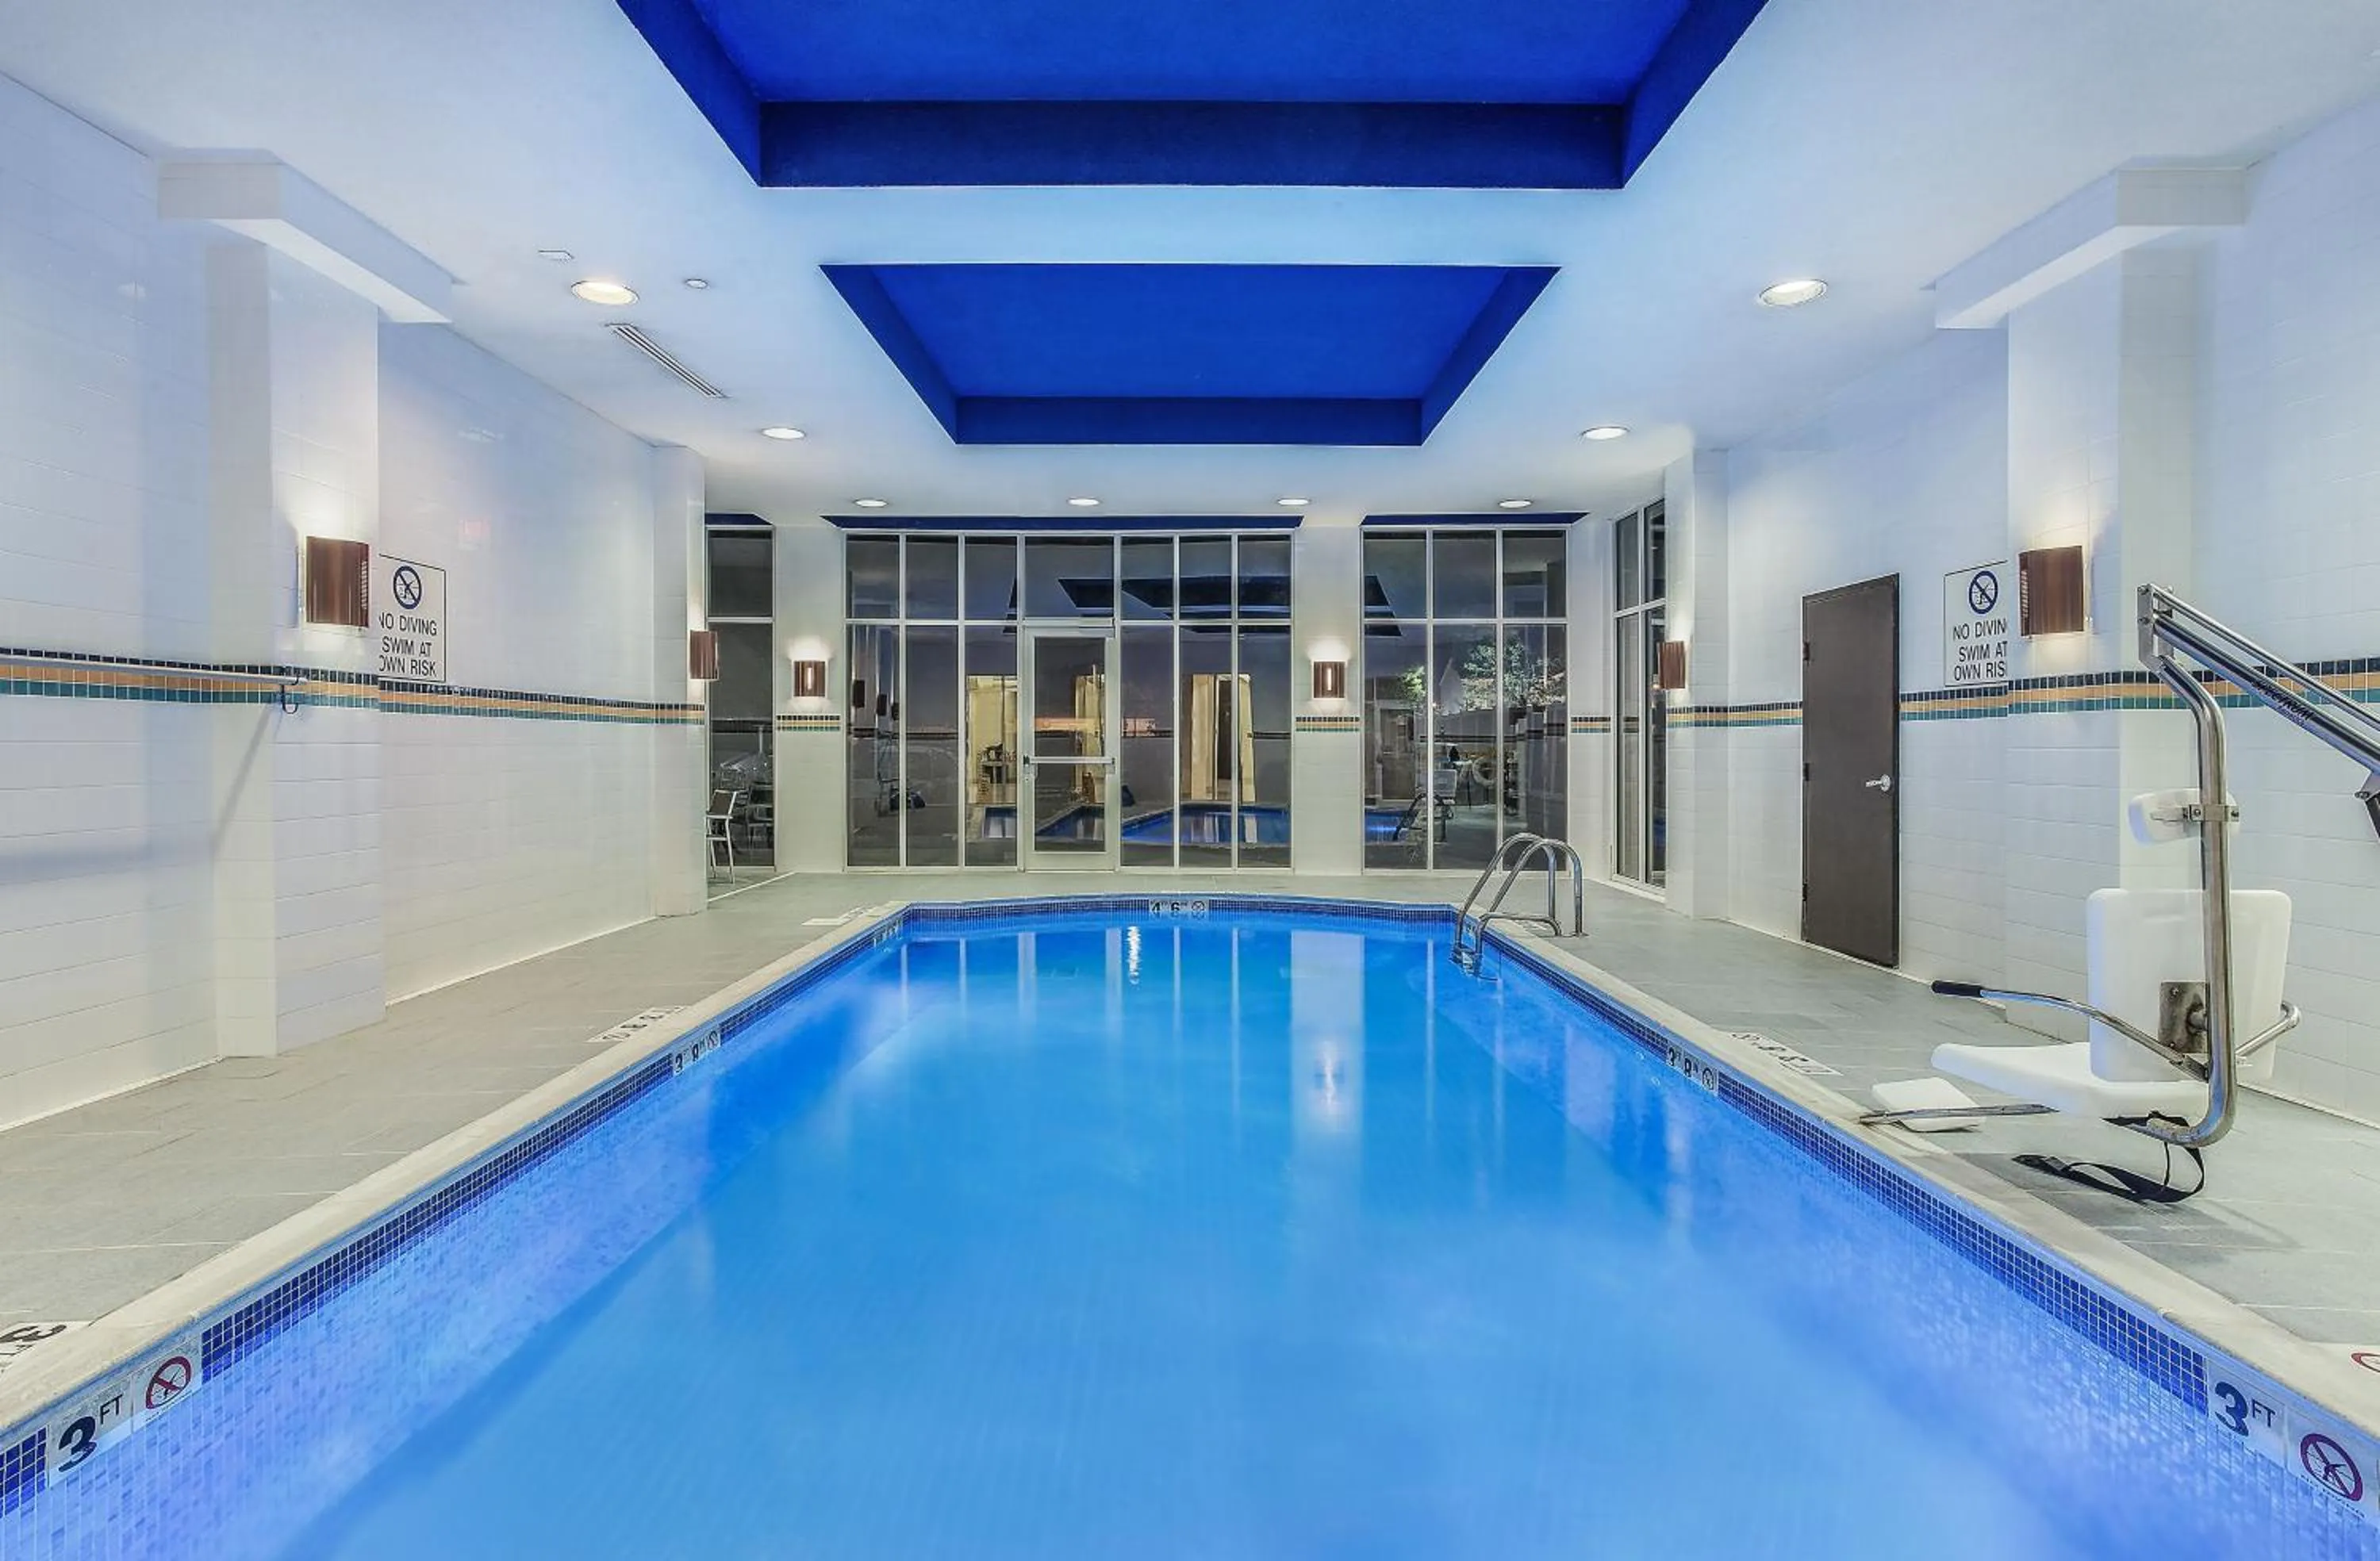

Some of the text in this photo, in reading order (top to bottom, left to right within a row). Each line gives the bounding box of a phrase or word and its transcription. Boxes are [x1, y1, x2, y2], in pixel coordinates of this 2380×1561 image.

[399, 615, 437, 636] DIVING
[1953, 618, 2008, 641] NO DIVIN
[382, 636, 432, 658] SWIM AT
[1959, 641, 2008, 662] SWIM AT
[410, 659, 436, 677] RISK
[1954, 661, 2008, 681] OWN RIS
[2215, 1381, 2275, 1436] 3 FT
[59, 1394, 123, 1471] 3 FT
